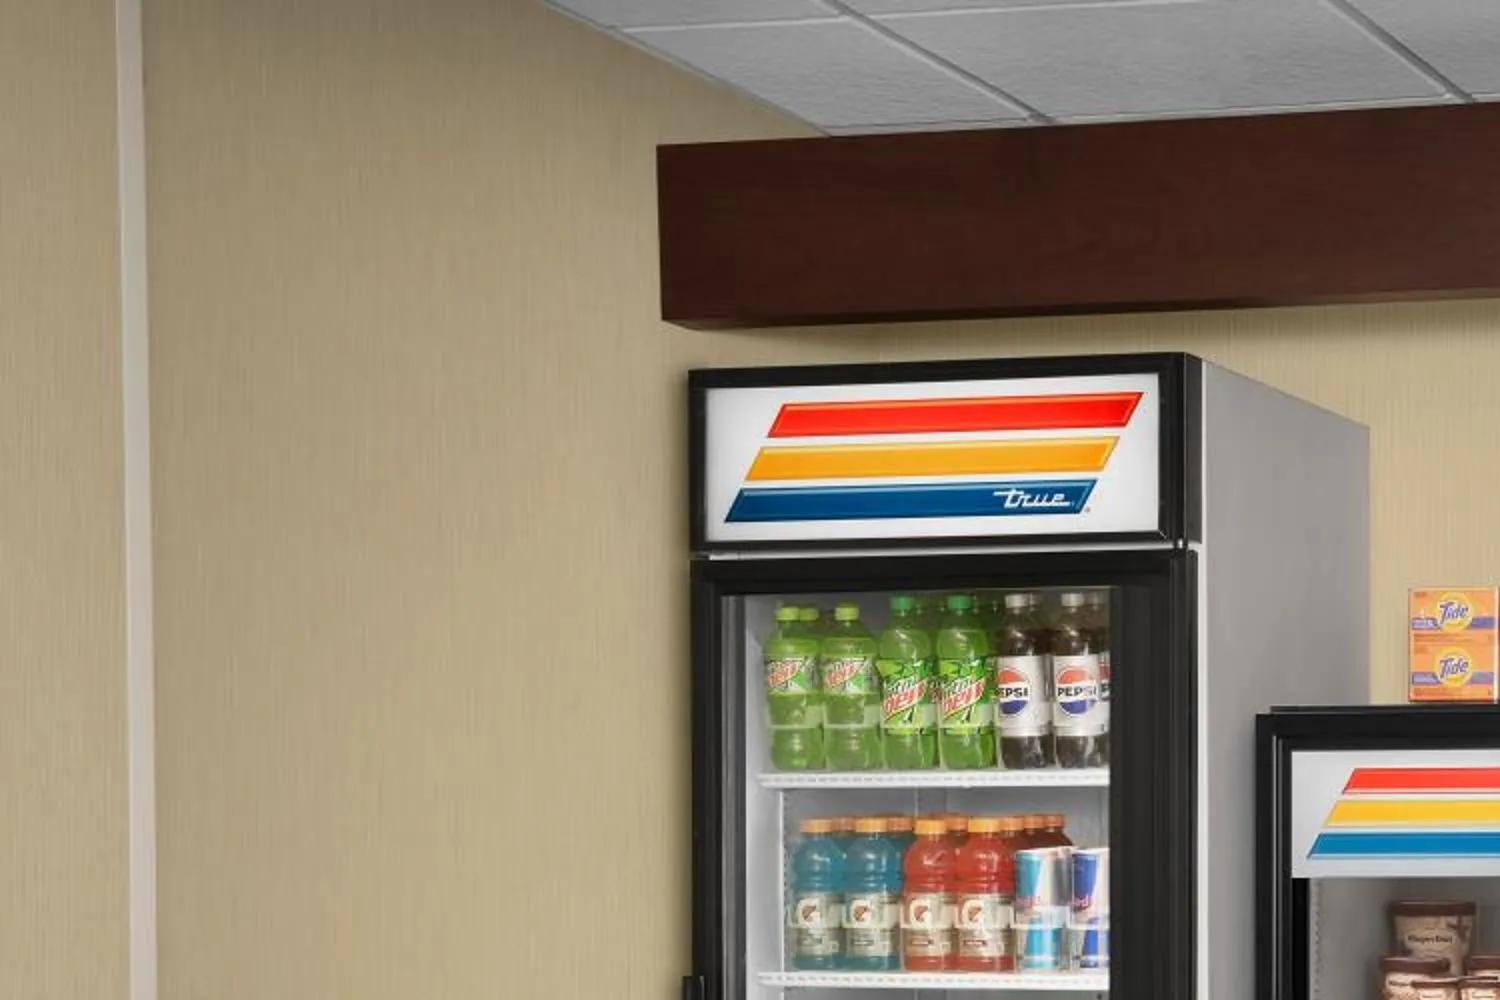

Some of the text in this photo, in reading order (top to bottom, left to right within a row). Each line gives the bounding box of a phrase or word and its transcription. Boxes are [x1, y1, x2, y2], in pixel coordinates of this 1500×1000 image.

[1438, 601, 1469, 624] Tide
[1438, 656, 1469, 679] Tide
[1056, 686, 1099, 698] PEPSI
